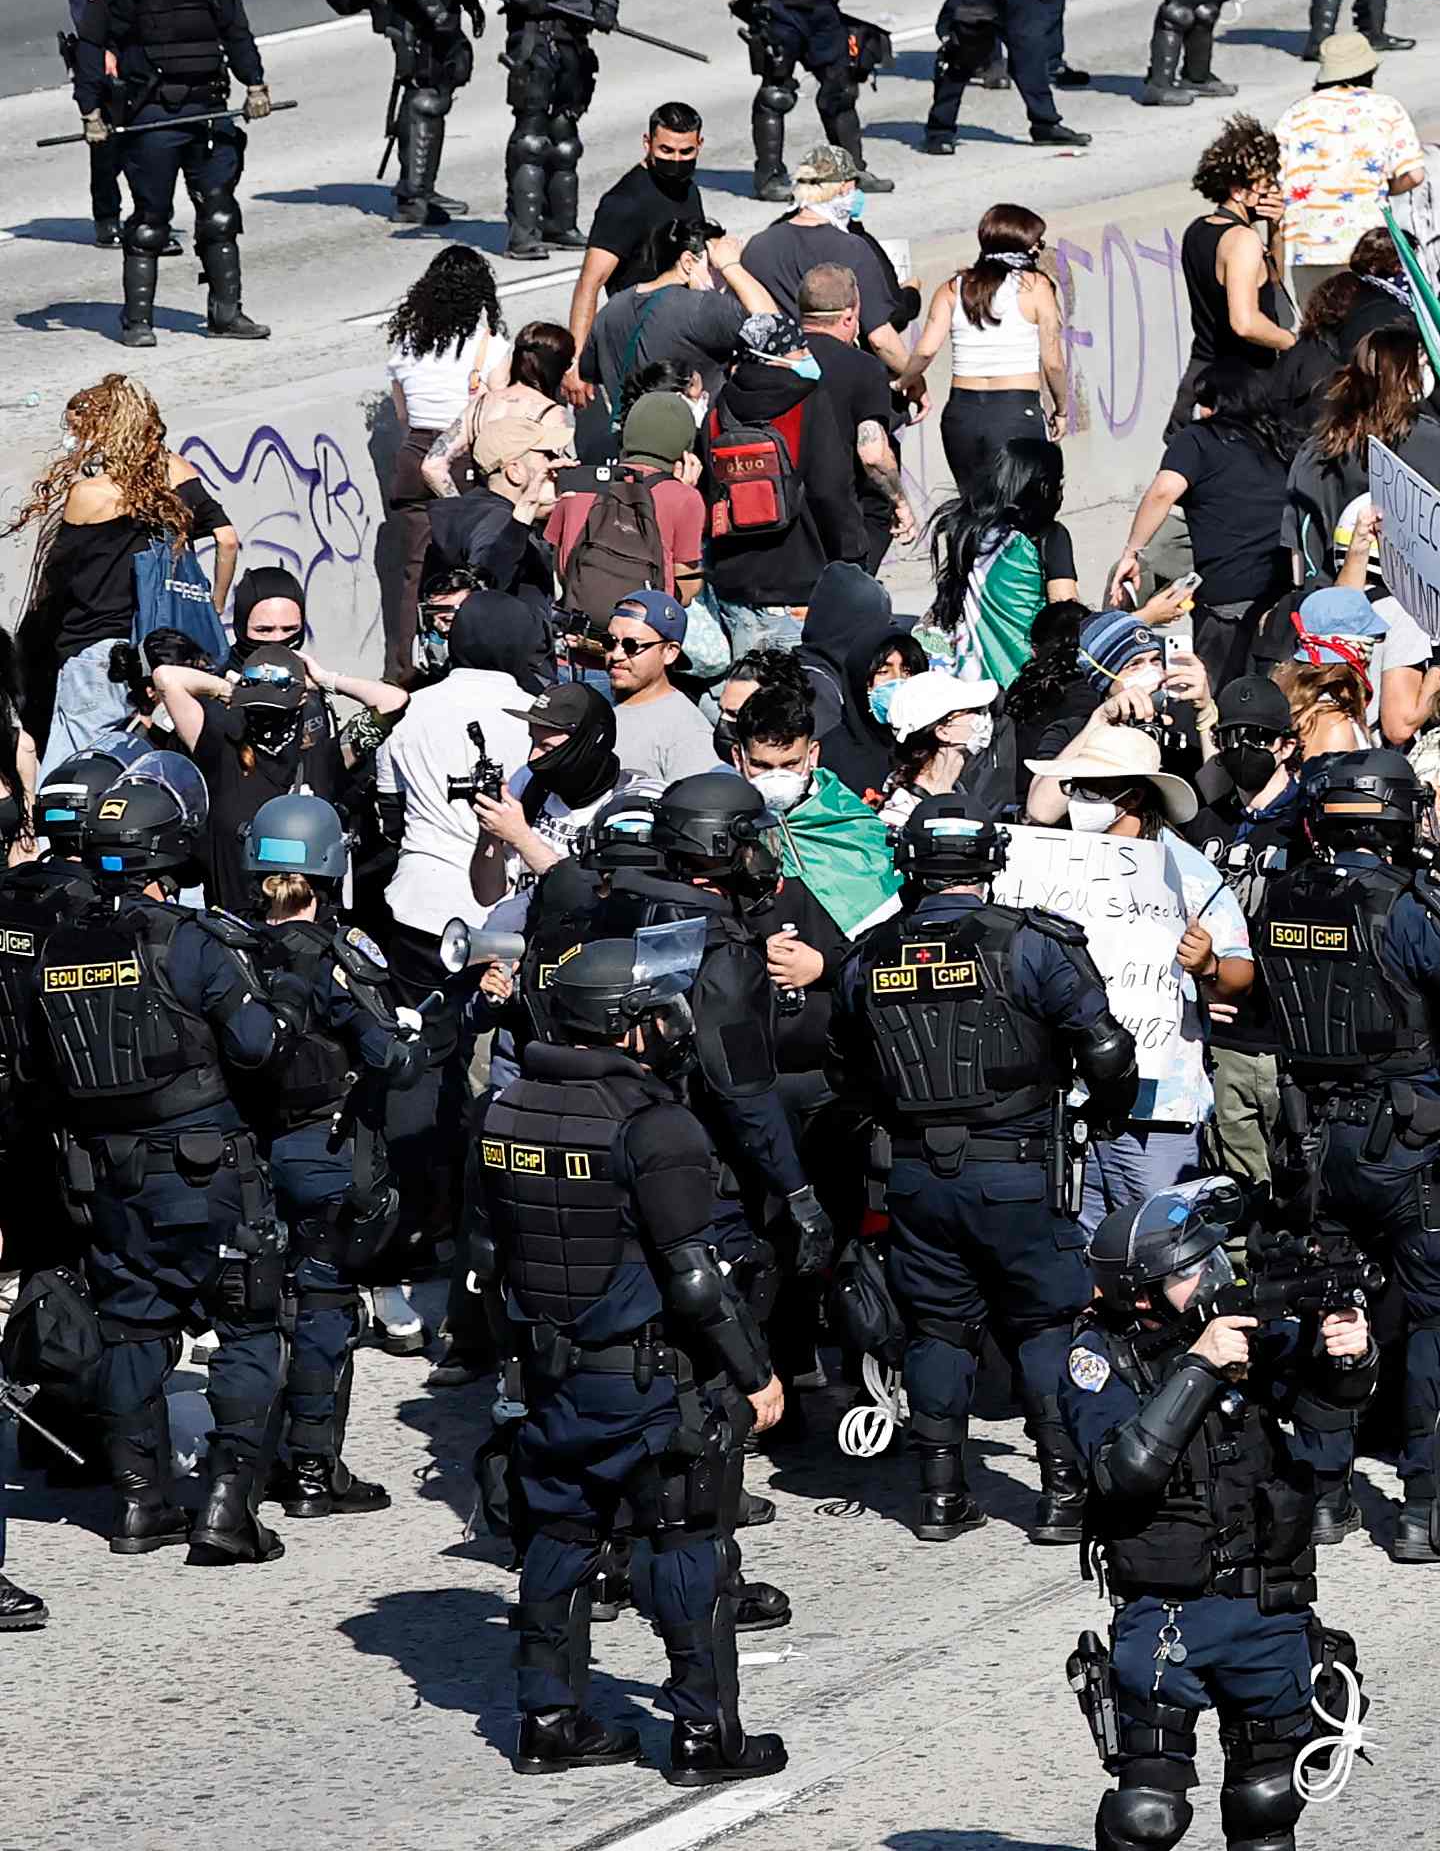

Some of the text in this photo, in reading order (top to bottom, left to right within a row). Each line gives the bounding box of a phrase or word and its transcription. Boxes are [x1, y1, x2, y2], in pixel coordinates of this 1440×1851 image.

[1034, 834, 1139, 884] THIS
[9, 934, 31, 951] CHP
[1276, 924, 1343, 947] SOU CHP
[49, 968, 113, 987] SOU CHP
[878, 967, 970, 988] SOU CHP
[484, 1145, 541, 1169] SOU CHP
